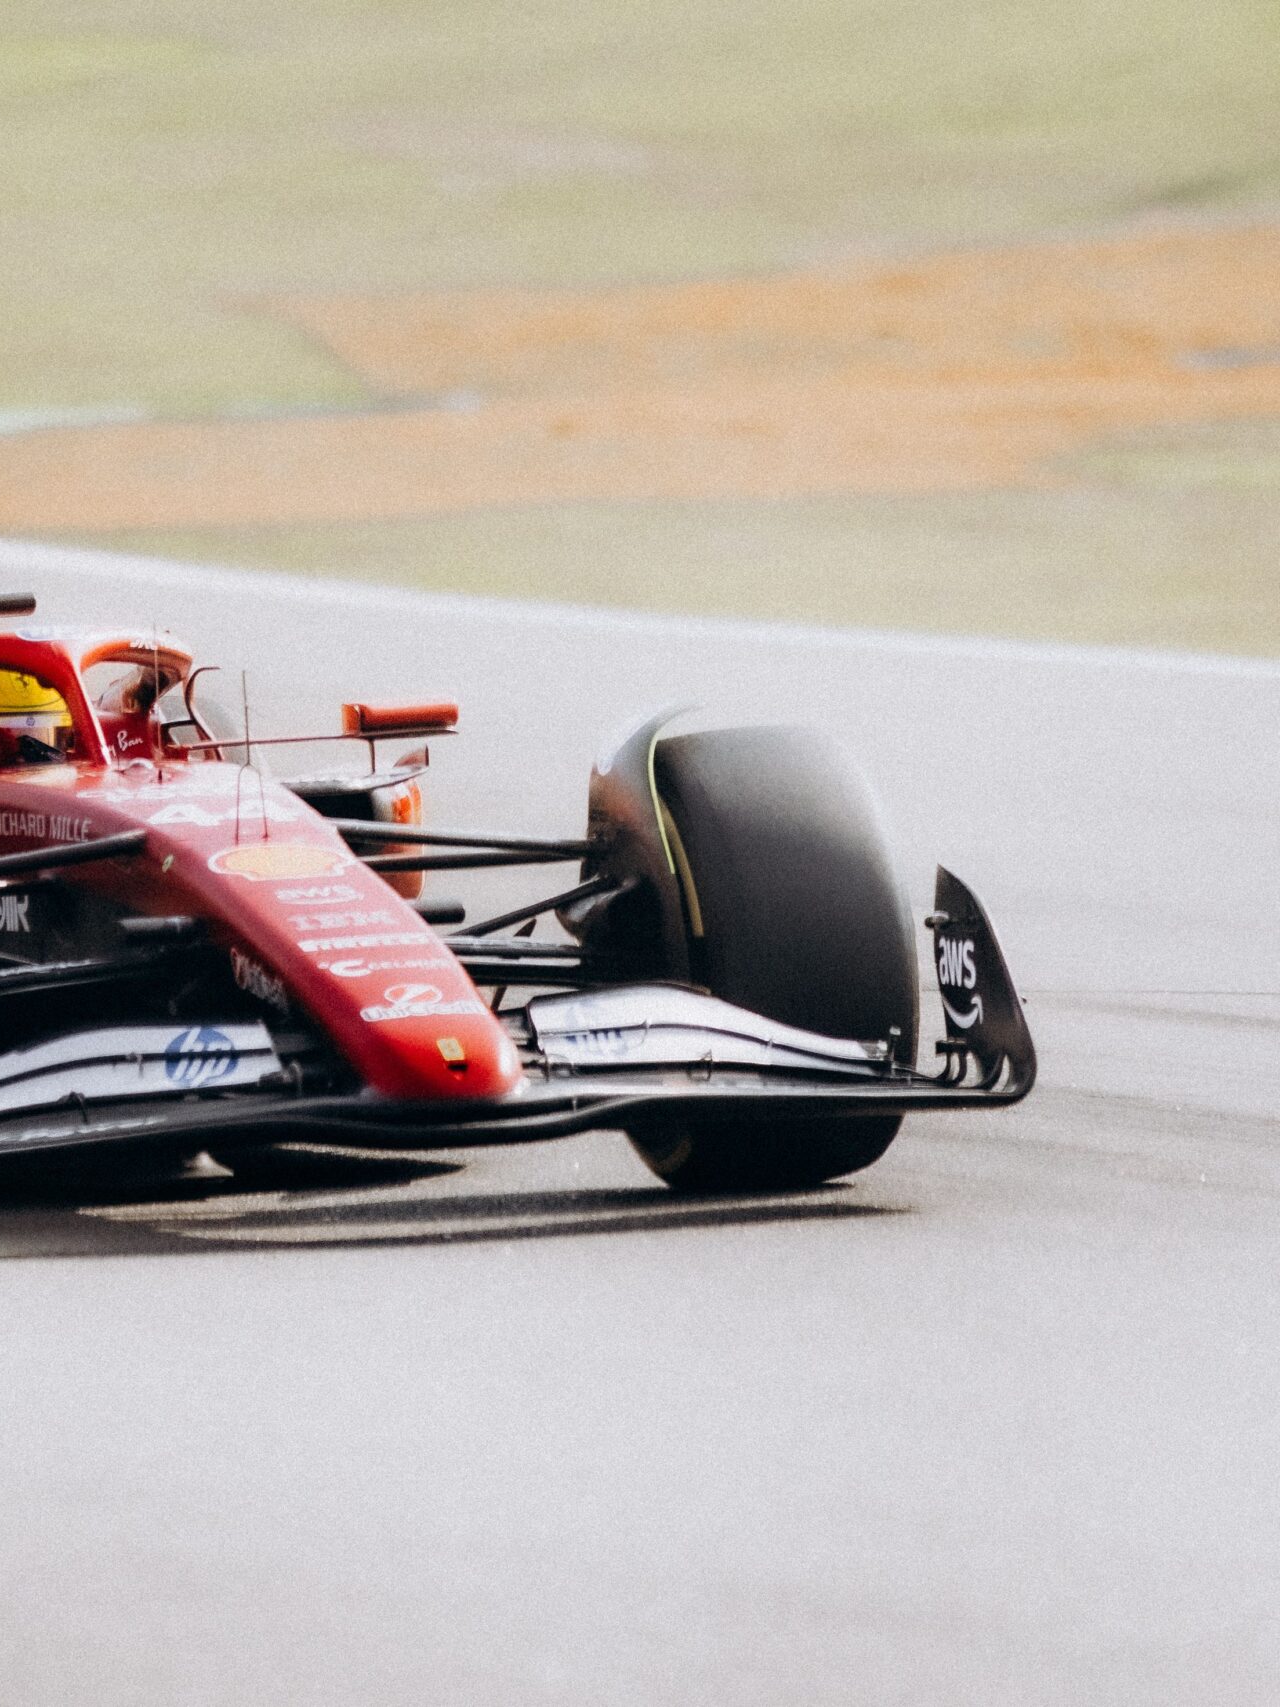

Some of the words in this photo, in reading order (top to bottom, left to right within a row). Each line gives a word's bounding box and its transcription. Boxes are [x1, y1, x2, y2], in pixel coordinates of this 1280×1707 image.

[49, 815, 93, 842] MILLE
[939, 935, 977, 990] aws
[167, 1026, 235, 1087] hp
